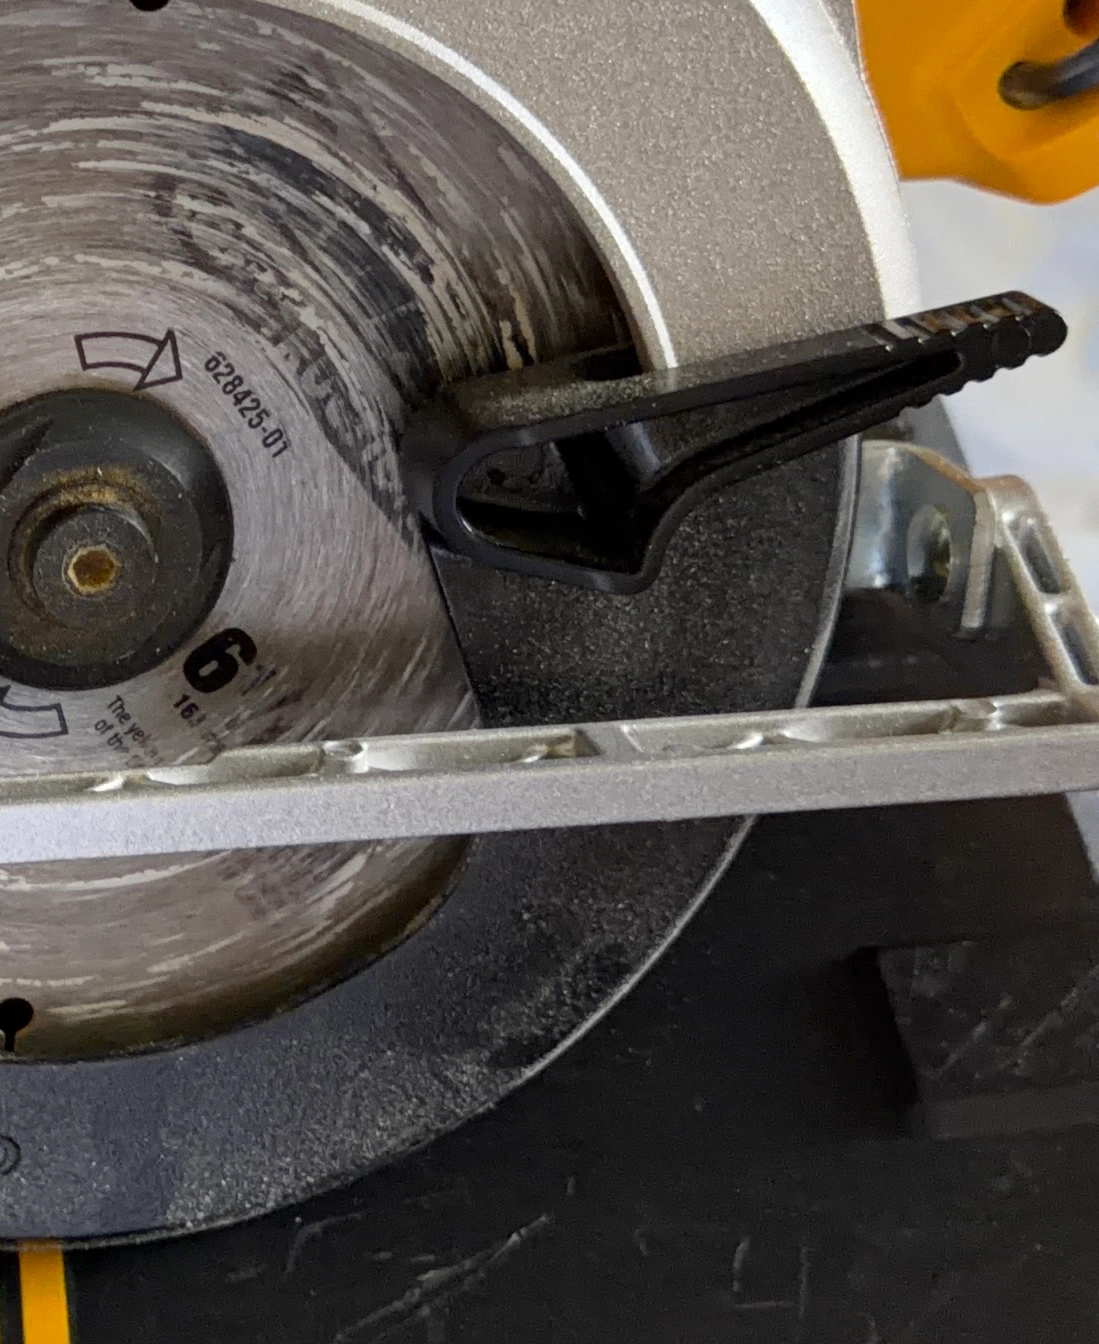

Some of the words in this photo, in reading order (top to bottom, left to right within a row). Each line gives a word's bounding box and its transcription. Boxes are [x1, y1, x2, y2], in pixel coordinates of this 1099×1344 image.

[204, 351, 290, 458] 628425-01
[183, 627, 257, 693] 6
[94, 718, 114, 736] of
[107, 694, 132, 725] The
